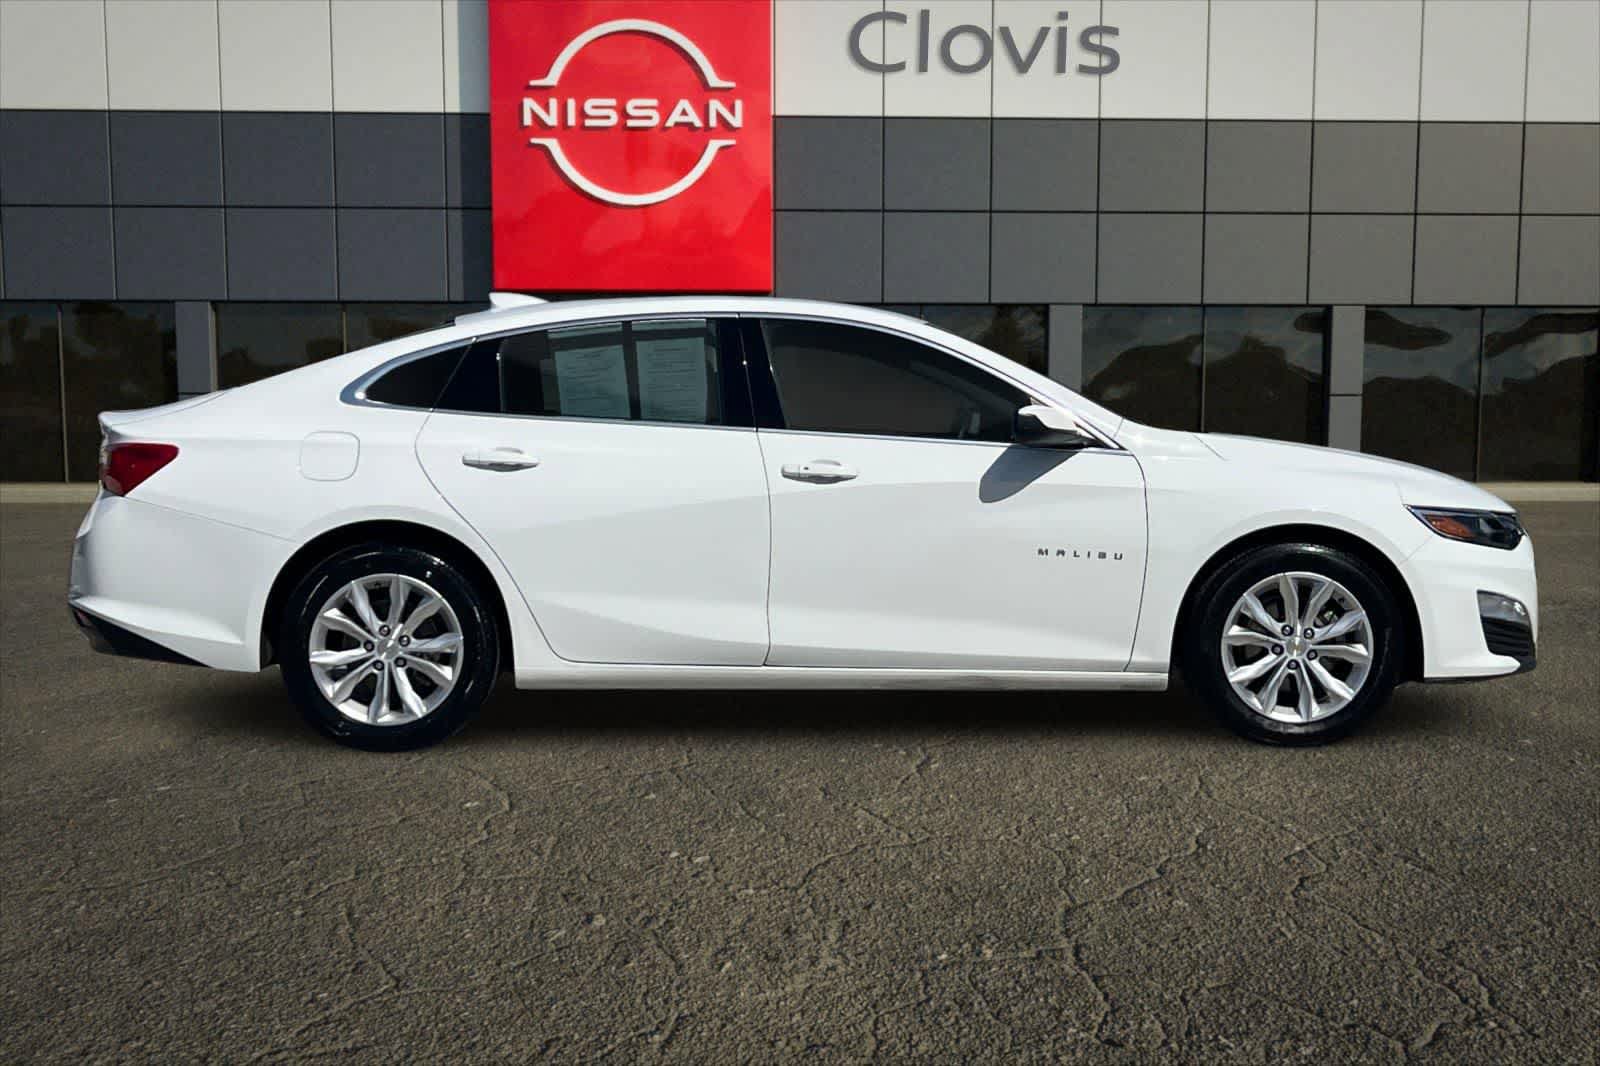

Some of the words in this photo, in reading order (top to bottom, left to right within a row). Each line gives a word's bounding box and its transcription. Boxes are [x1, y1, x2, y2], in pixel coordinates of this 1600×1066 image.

[848, 9, 1121, 75] Clovis
[522, 97, 744, 130] NISSAN
[1037, 548, 1123, 560] MALIBU
